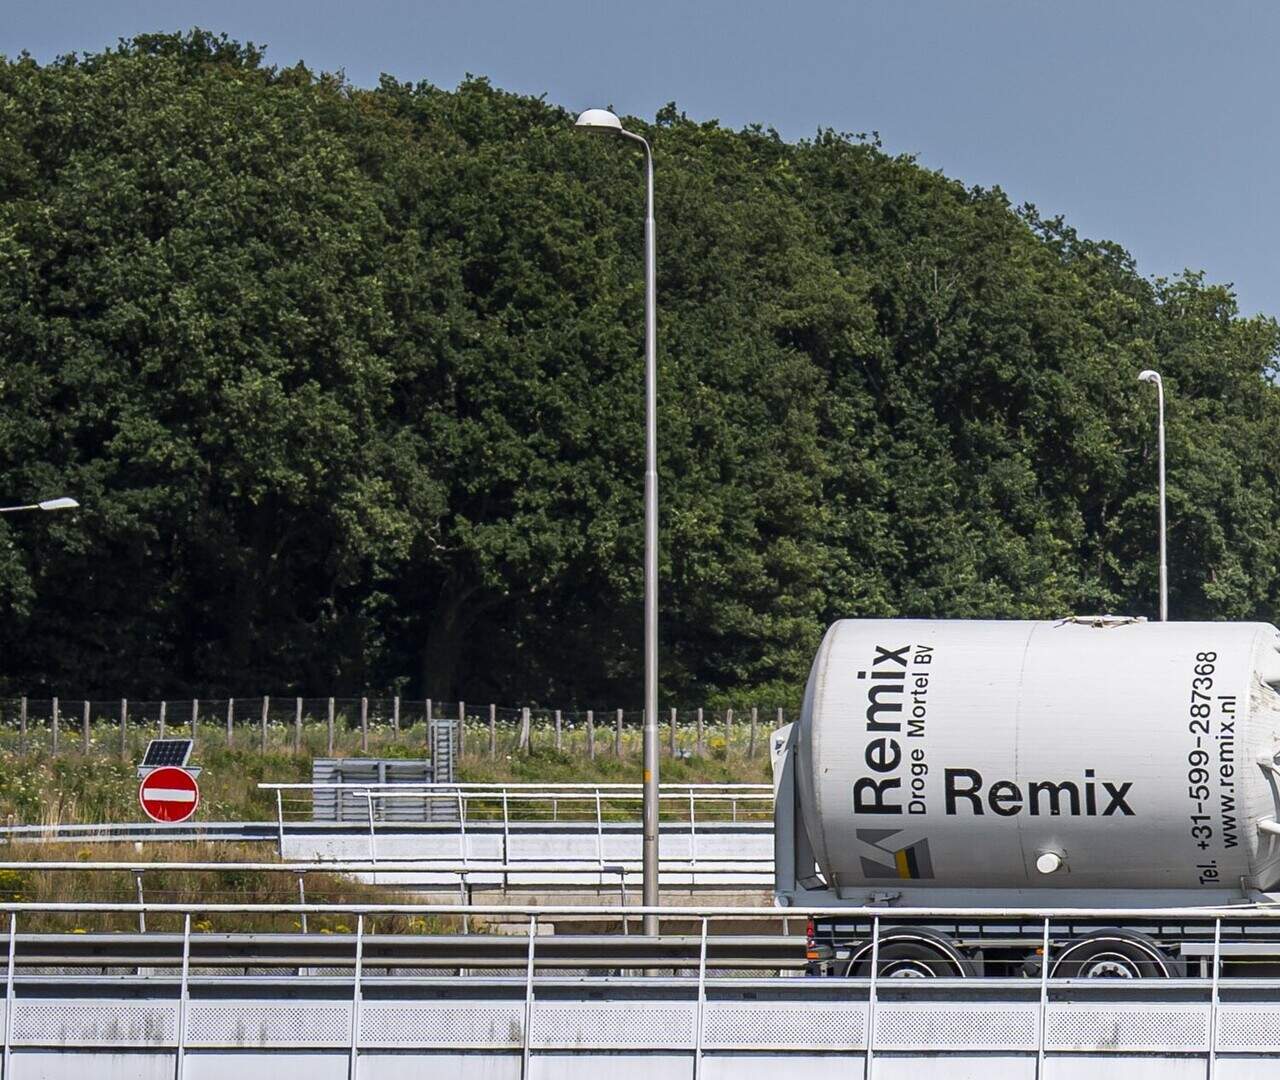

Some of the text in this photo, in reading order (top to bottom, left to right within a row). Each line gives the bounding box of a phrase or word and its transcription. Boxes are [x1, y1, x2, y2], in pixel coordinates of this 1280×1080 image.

[854, 645, 912, 815] Remix
[907, 644, 934, 815] Droge Mortel BV
[945, 768, 1136, 817] Remix
[1189, 651, 1220, 885] Tel. +31-599-287368
[1216, 695, 1238, 849] www.remix.nl
